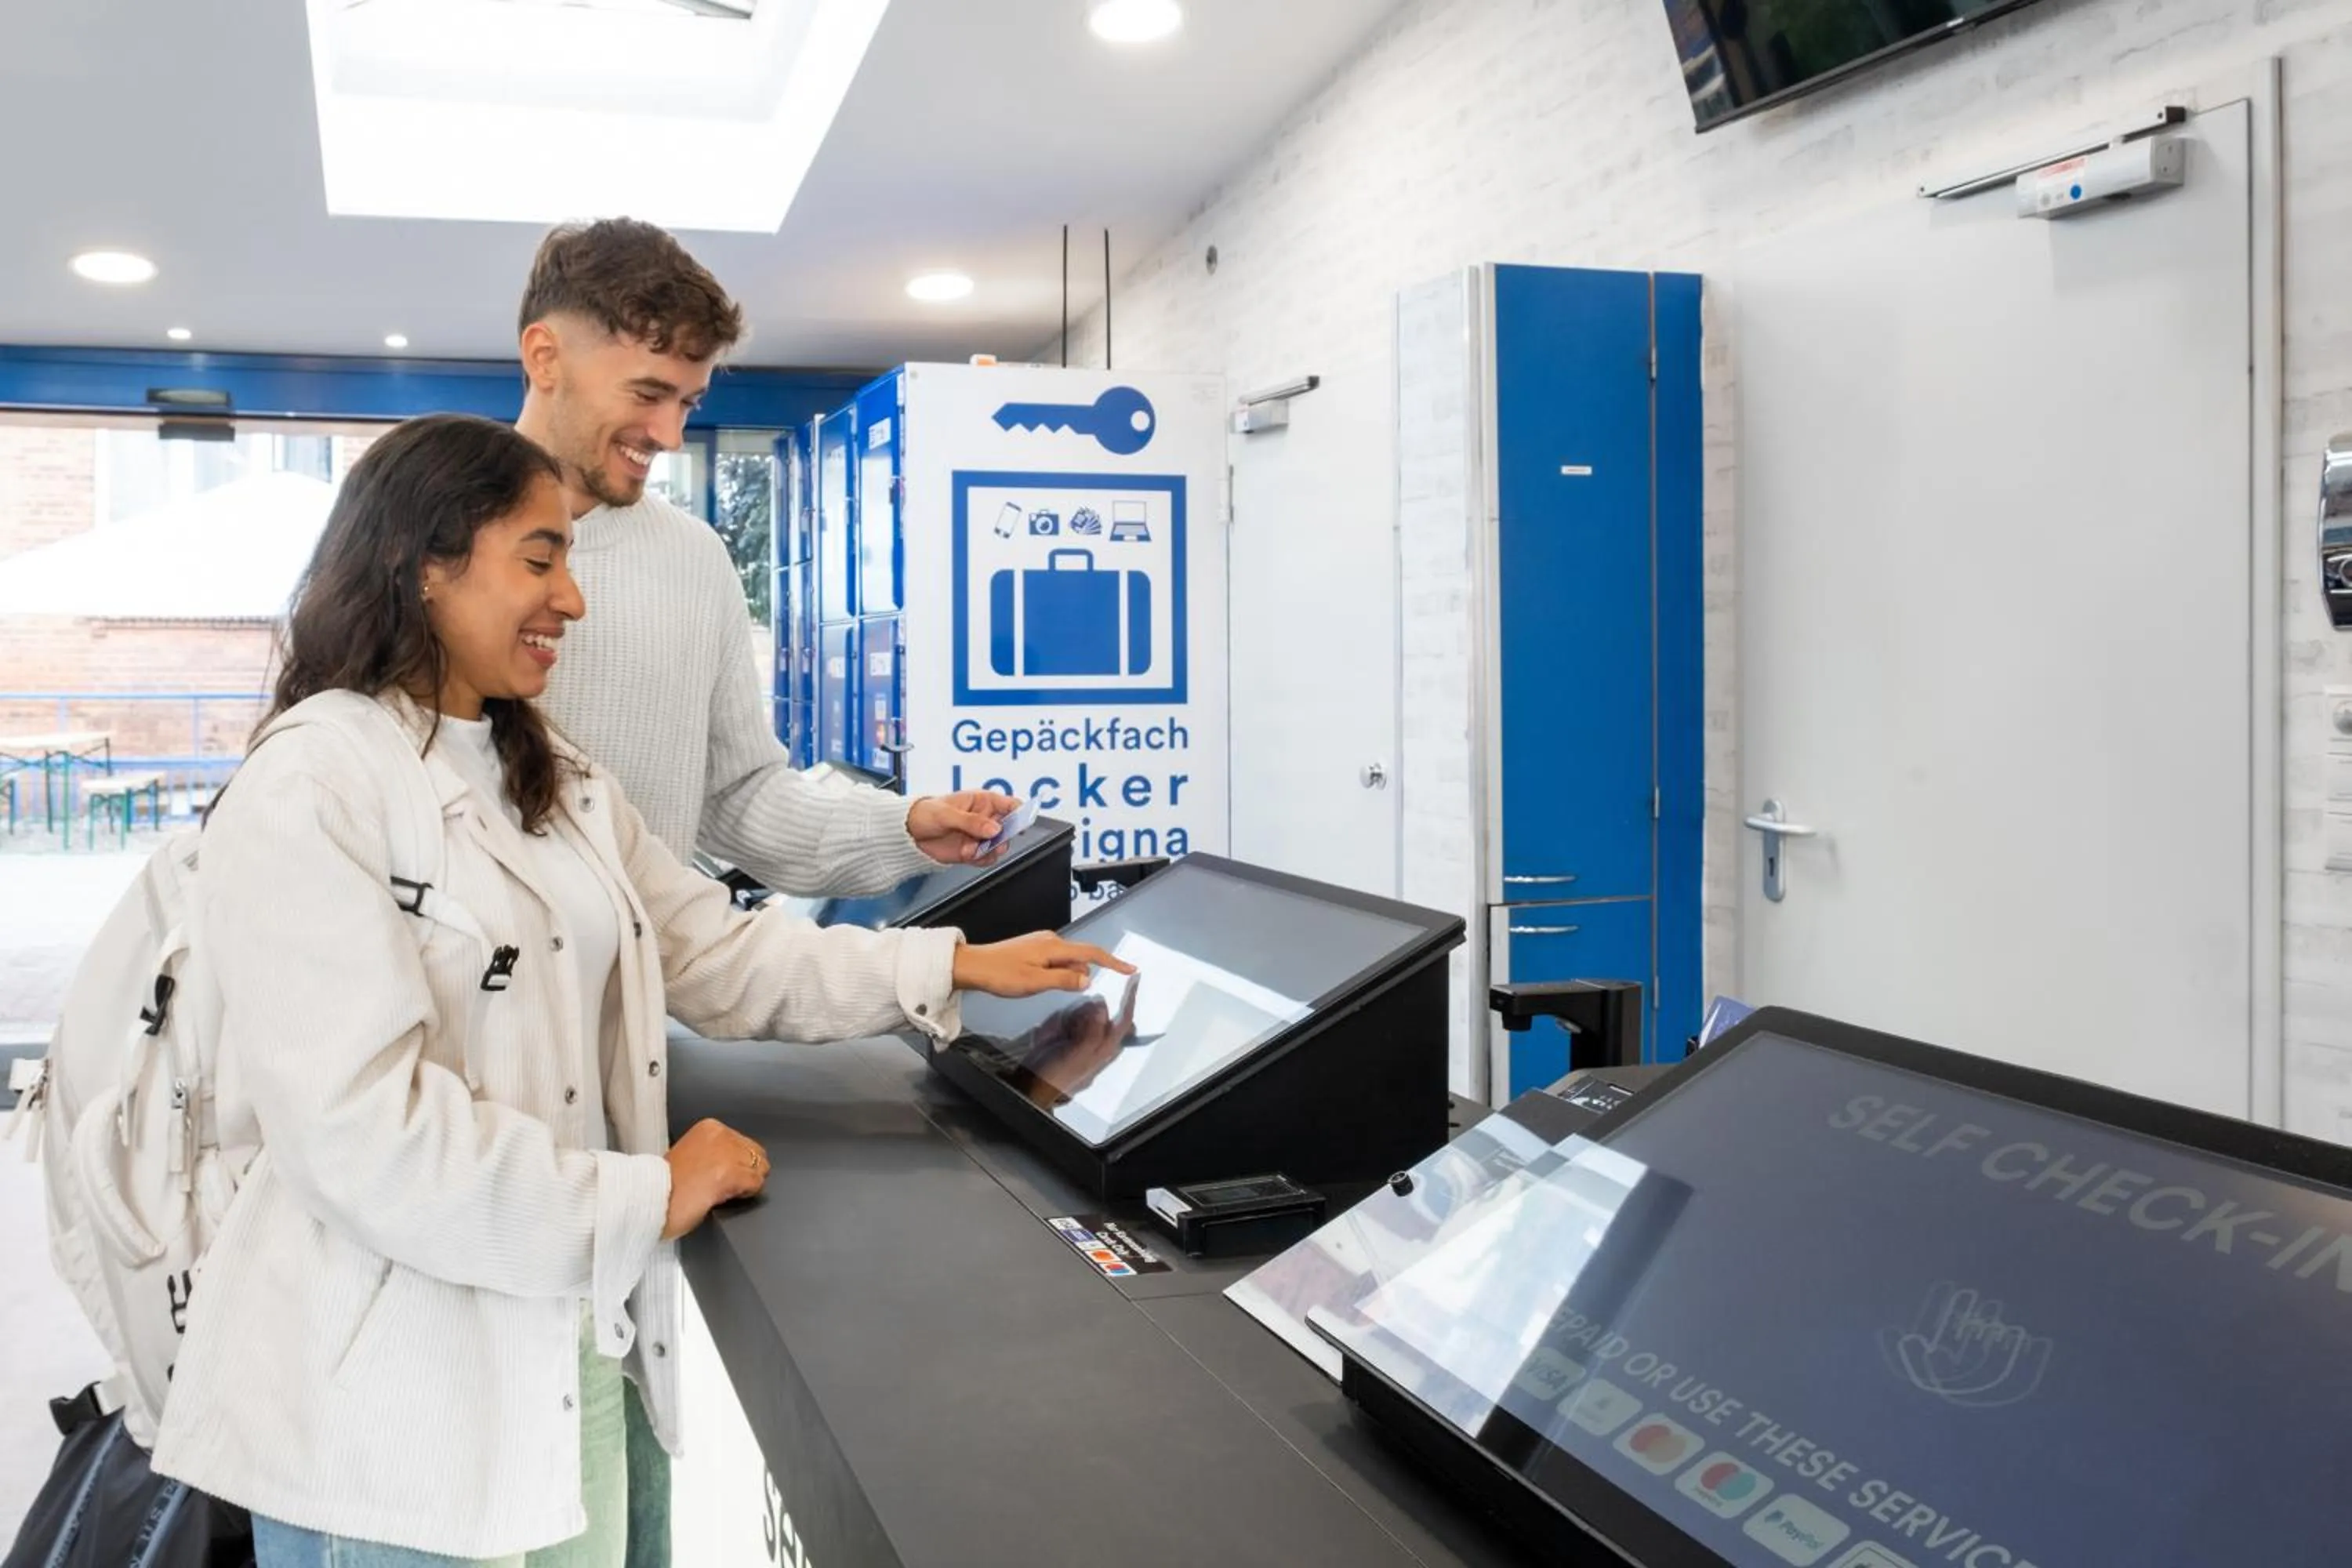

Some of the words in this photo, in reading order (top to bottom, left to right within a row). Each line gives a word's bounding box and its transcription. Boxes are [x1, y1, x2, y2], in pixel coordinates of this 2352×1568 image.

[952, 717, 1189, 760] Gepäckfach
[1082, 818, 1189, 860] igna
[1828, 1095, 1991, 1158] SELF
[1981, 1142, 2352, 1294] CHECK-IN
[1545, 1305, 1629, 1359] EPAID
[1624, 1352, 1678, 1387] OR
[1669, 1376, 1744, 1426] USE
[1735, 1411, 1860, 1491] THESE
[1848, 1479, 2040, 1568] SERVIC
